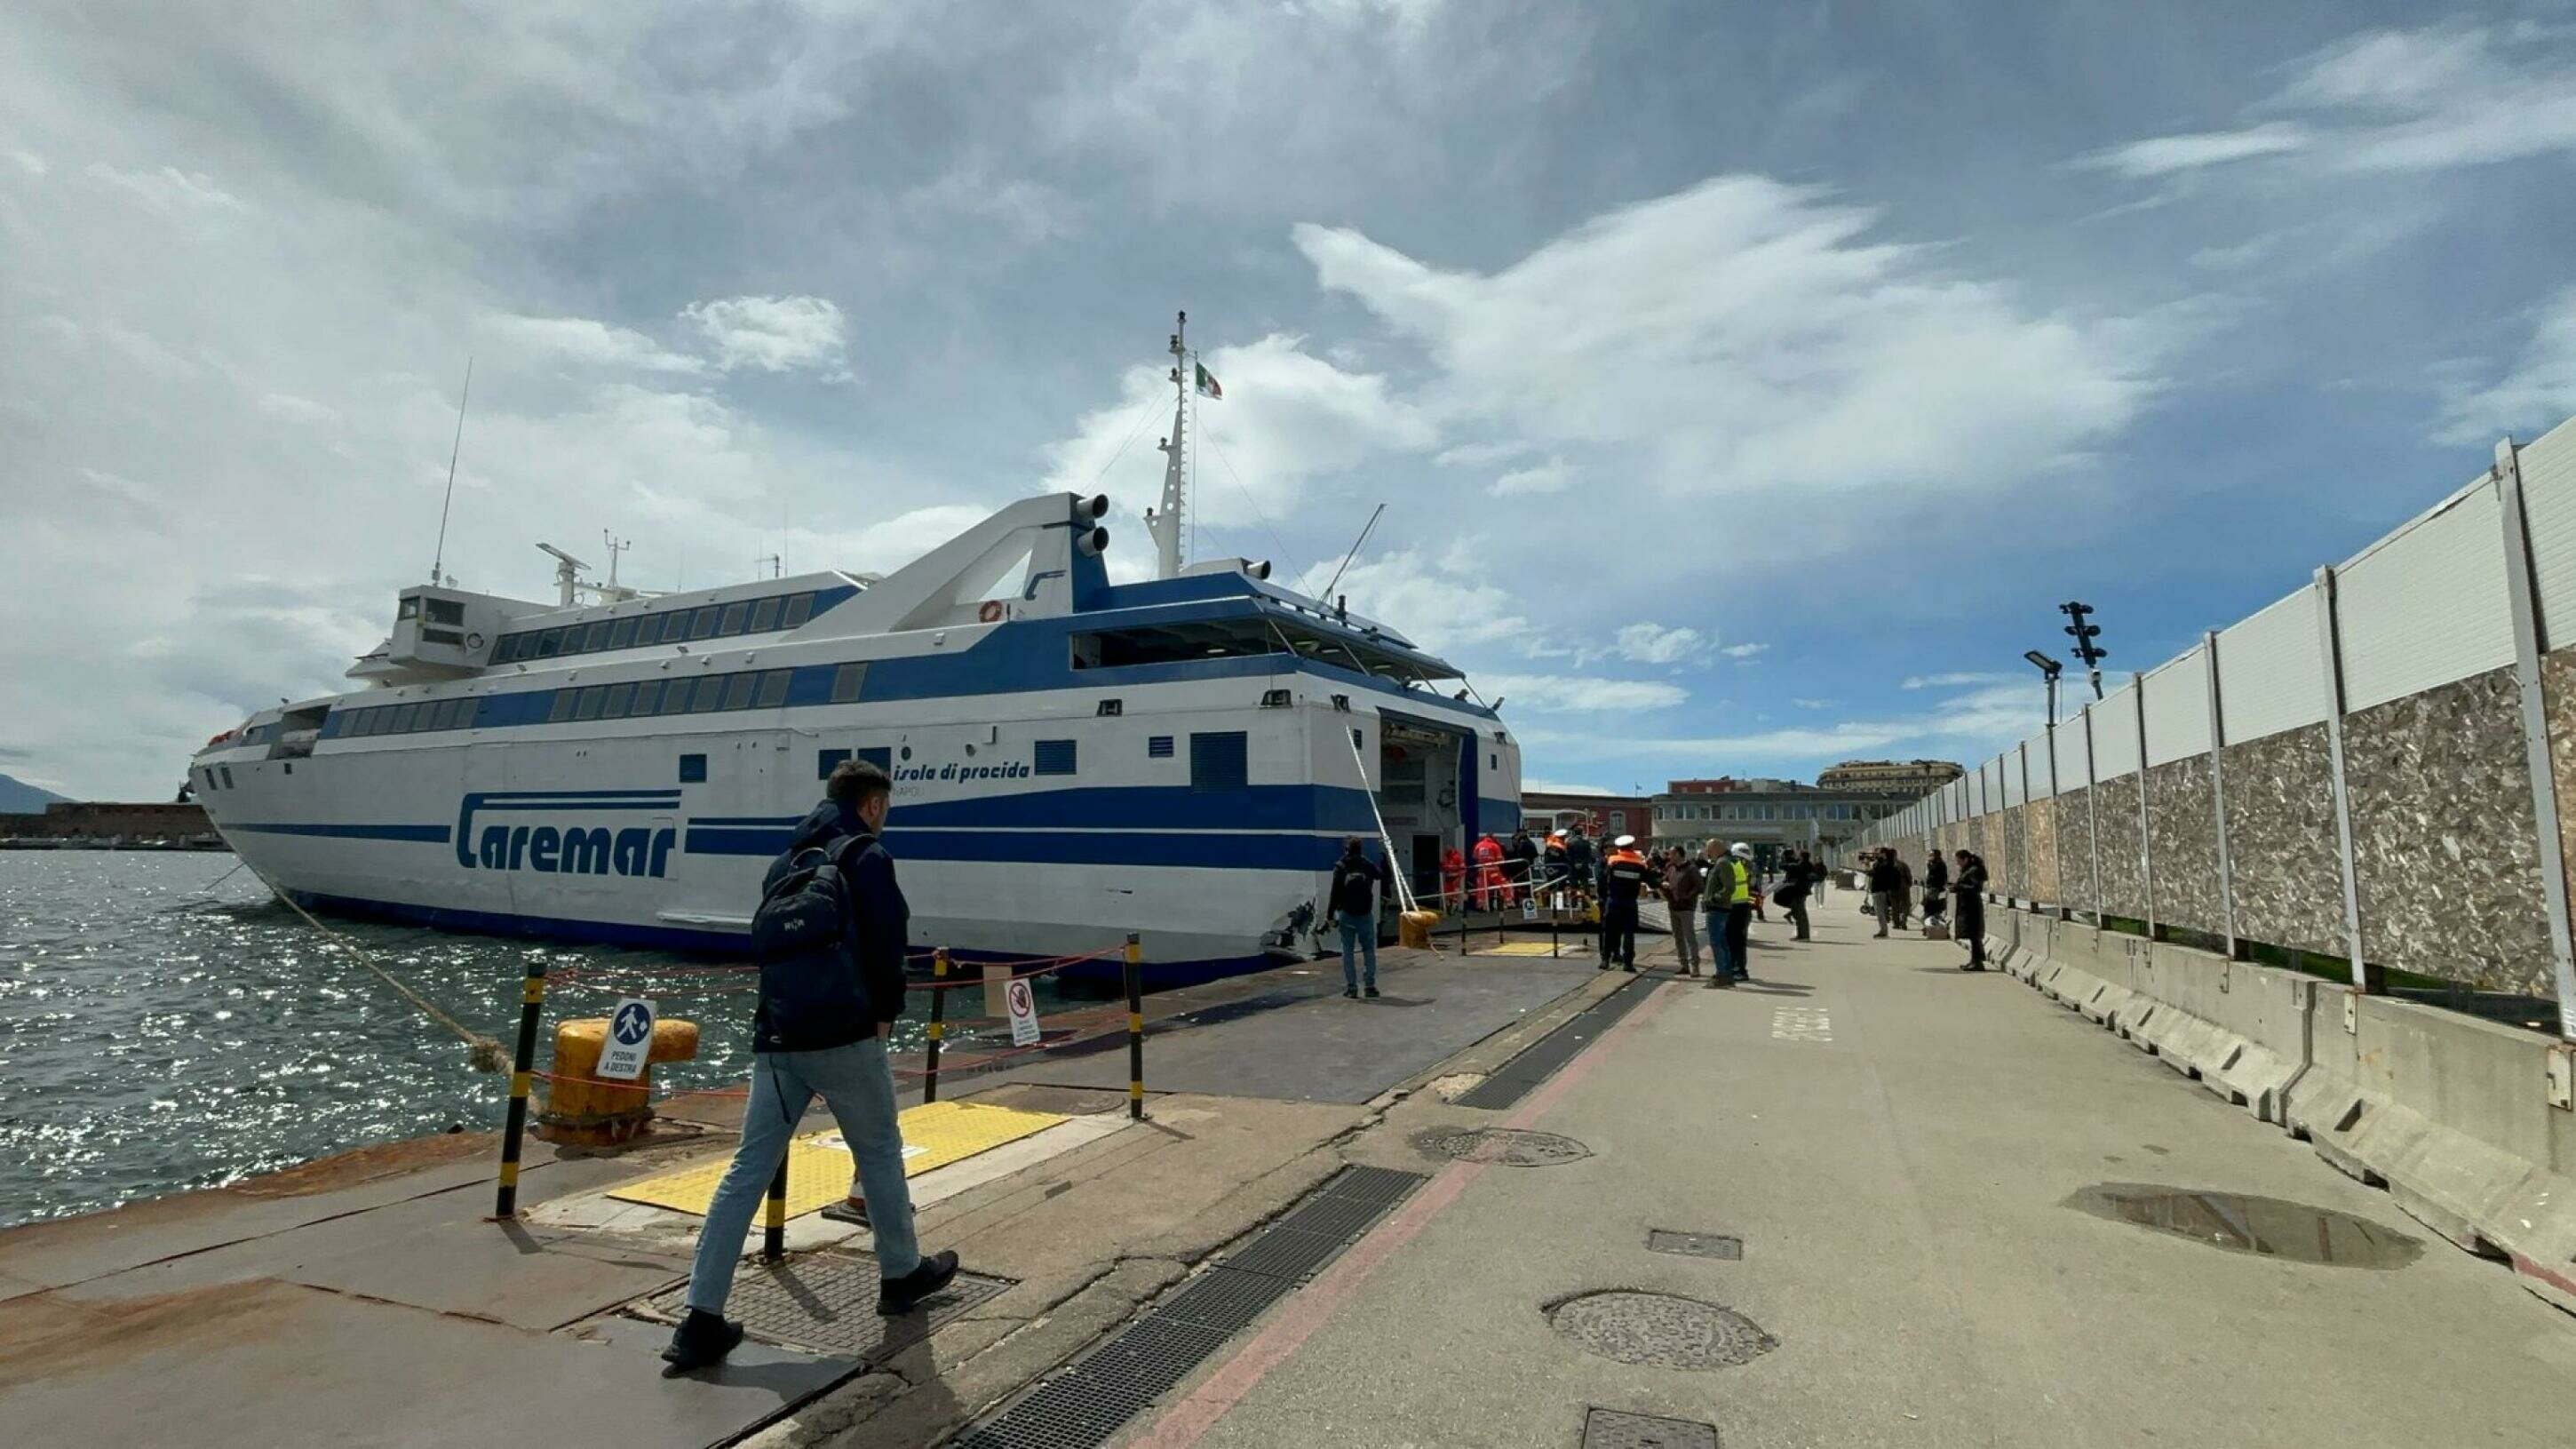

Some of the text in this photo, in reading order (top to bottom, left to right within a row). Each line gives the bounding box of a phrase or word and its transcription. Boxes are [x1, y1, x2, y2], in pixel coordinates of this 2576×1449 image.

[894, 761, 1030, 784] isola di procida
[457, 790, 682, 878] Caremar
[611, 1051, 637, 1062] PEDONI
[610, 1062, 637, 1073] DESTRA
